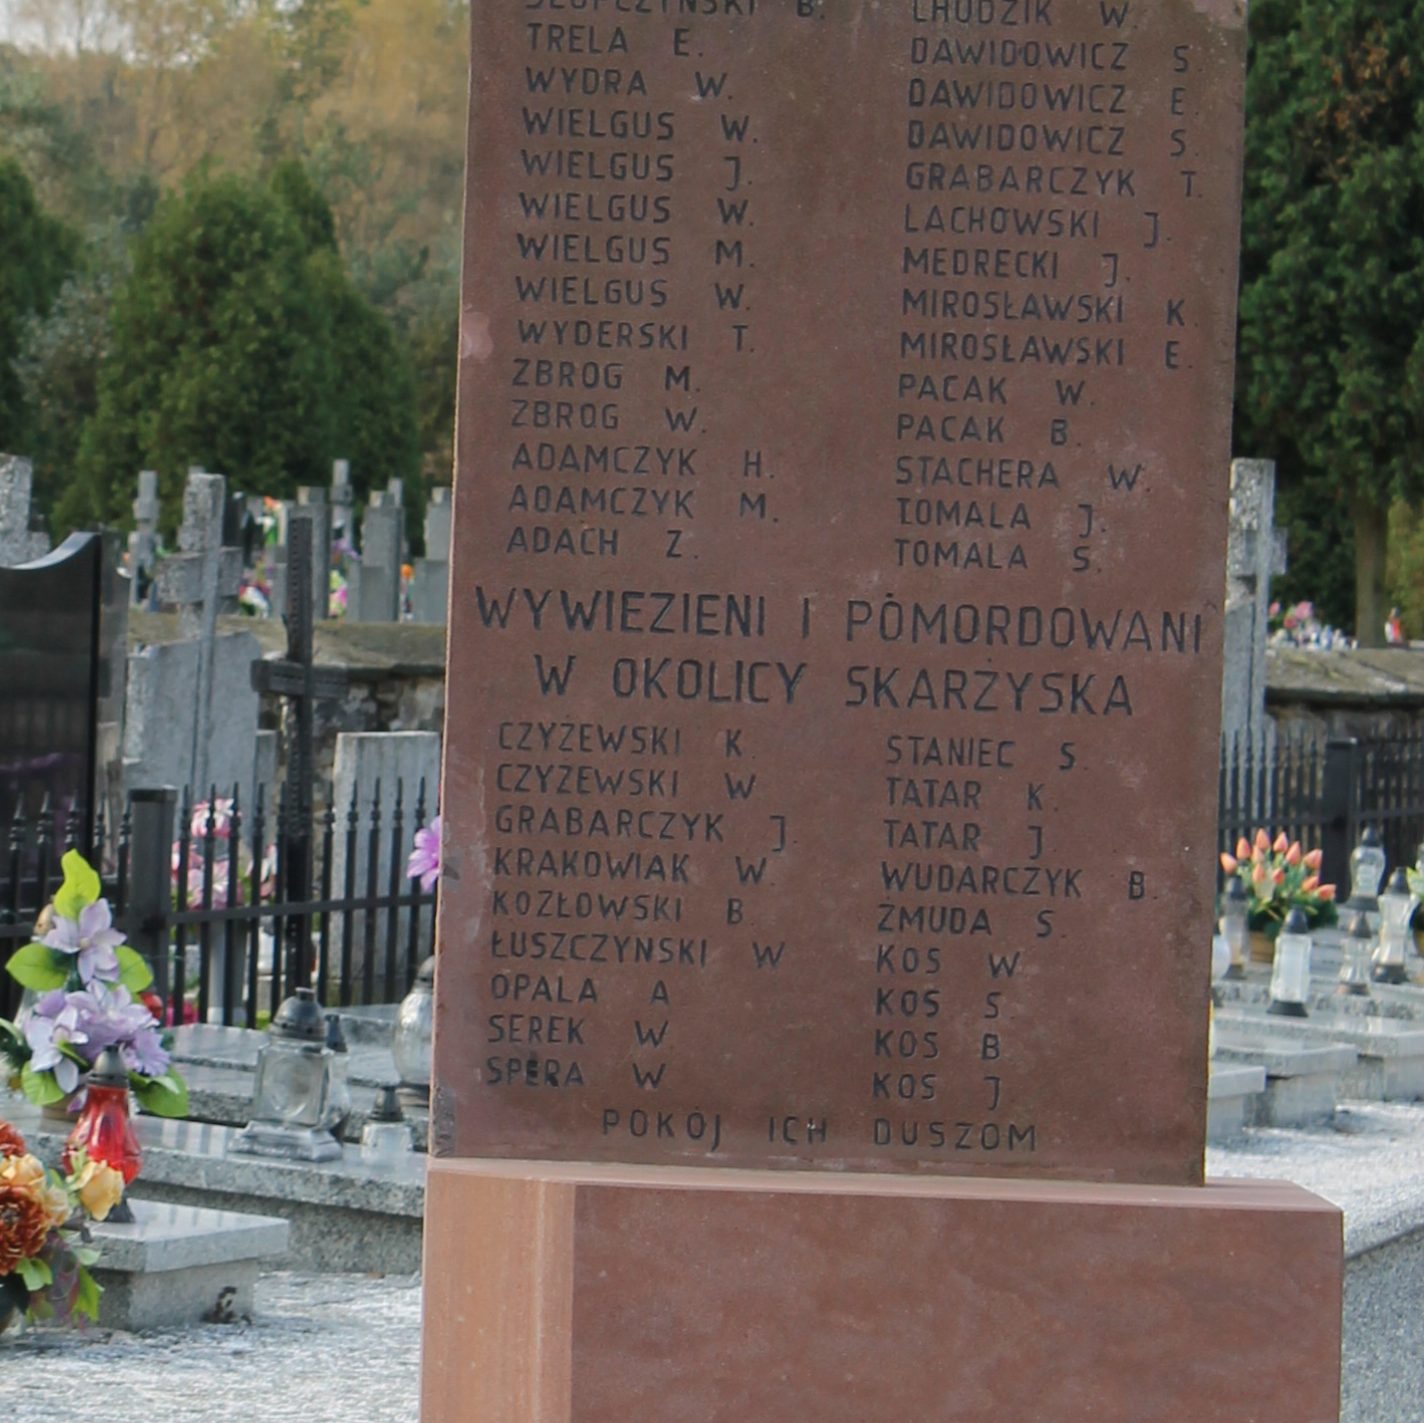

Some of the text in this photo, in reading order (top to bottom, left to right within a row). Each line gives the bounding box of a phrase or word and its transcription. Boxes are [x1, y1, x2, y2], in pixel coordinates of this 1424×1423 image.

[525, 22, 629, 54] TRELA
[910, 36, 1129, 72] DAWIDOWICZ
[525, 66, 648, 96] WYDRA
[907, 77, 1127, 115] DAWIDOWICZ
[521, 106, 675, 141] WIELGUS
[906, 119, 1126, 157] DAWIDOWICZ
[519, 148, 675, 182] WIELGUS
[905, 161, 1136, 198] GRABARCZYK
[517, 191, 671, 224] WIELGUS
[904, 202, 1100, 238] LACHOWSKI
[516, 232, 671, 266] WIELGUS
[902, 245, 1059, 280] MEDRECKI
[514, 276, 669, 308] WIELGUS
[902, 288, 1124, 325] MIROSŁAWSKI
[517, 318, 689, 351] WYDERSKI
[900, 331, 1125, 367] MIROSŁAWSKI
[511, 357, 624, 390] ZBROG
[897, 373, 1008, 405] PACAK
[510, 399, 620, 430] ZBROG
[895, 412, 1005, 444] PACAK
[511, 442, 698, 476] ADAMCZYK
[895, 455, 1060, 489] STACHERA
[508, 484, 694, 520] ADAMCZYK
[506, 526, 619, 556] ADACH
[475, 585, 766, 638] WYWIEZIENI
[801, 596, 810, 640] I
[533, 653, 577, 697] W
[611, 657, 808, 706] OKOLICY
[885, 734, 1017, 769] STANIEC
[885, 776, 982, 810] TATAR
[495, 804, 725, 843] GRABARCZYK
[883, 819, 982, 853] TATAR
[493, 846, 691, 884] KRAKOWIAK
[880, 860, 1084, 899] WUDARCZYK
[491, 889, 683, 923] KOZŁOWSKI
[875, 943, 942, 976] KOS
[490, 972, 599, 1004] OPALA
[875, 987, 941, 1018] KOS
[486, 1013, 586, 1046] SEREK
[874, 1028, 939, 1059] KOS
[486, 1055, 585, 1088] SPERA
[871, 1071, 937, 1101] KOS
[768, 1115, 827, 1145] ICH
[872, 1118, 1036, 1152] DUSZOM
